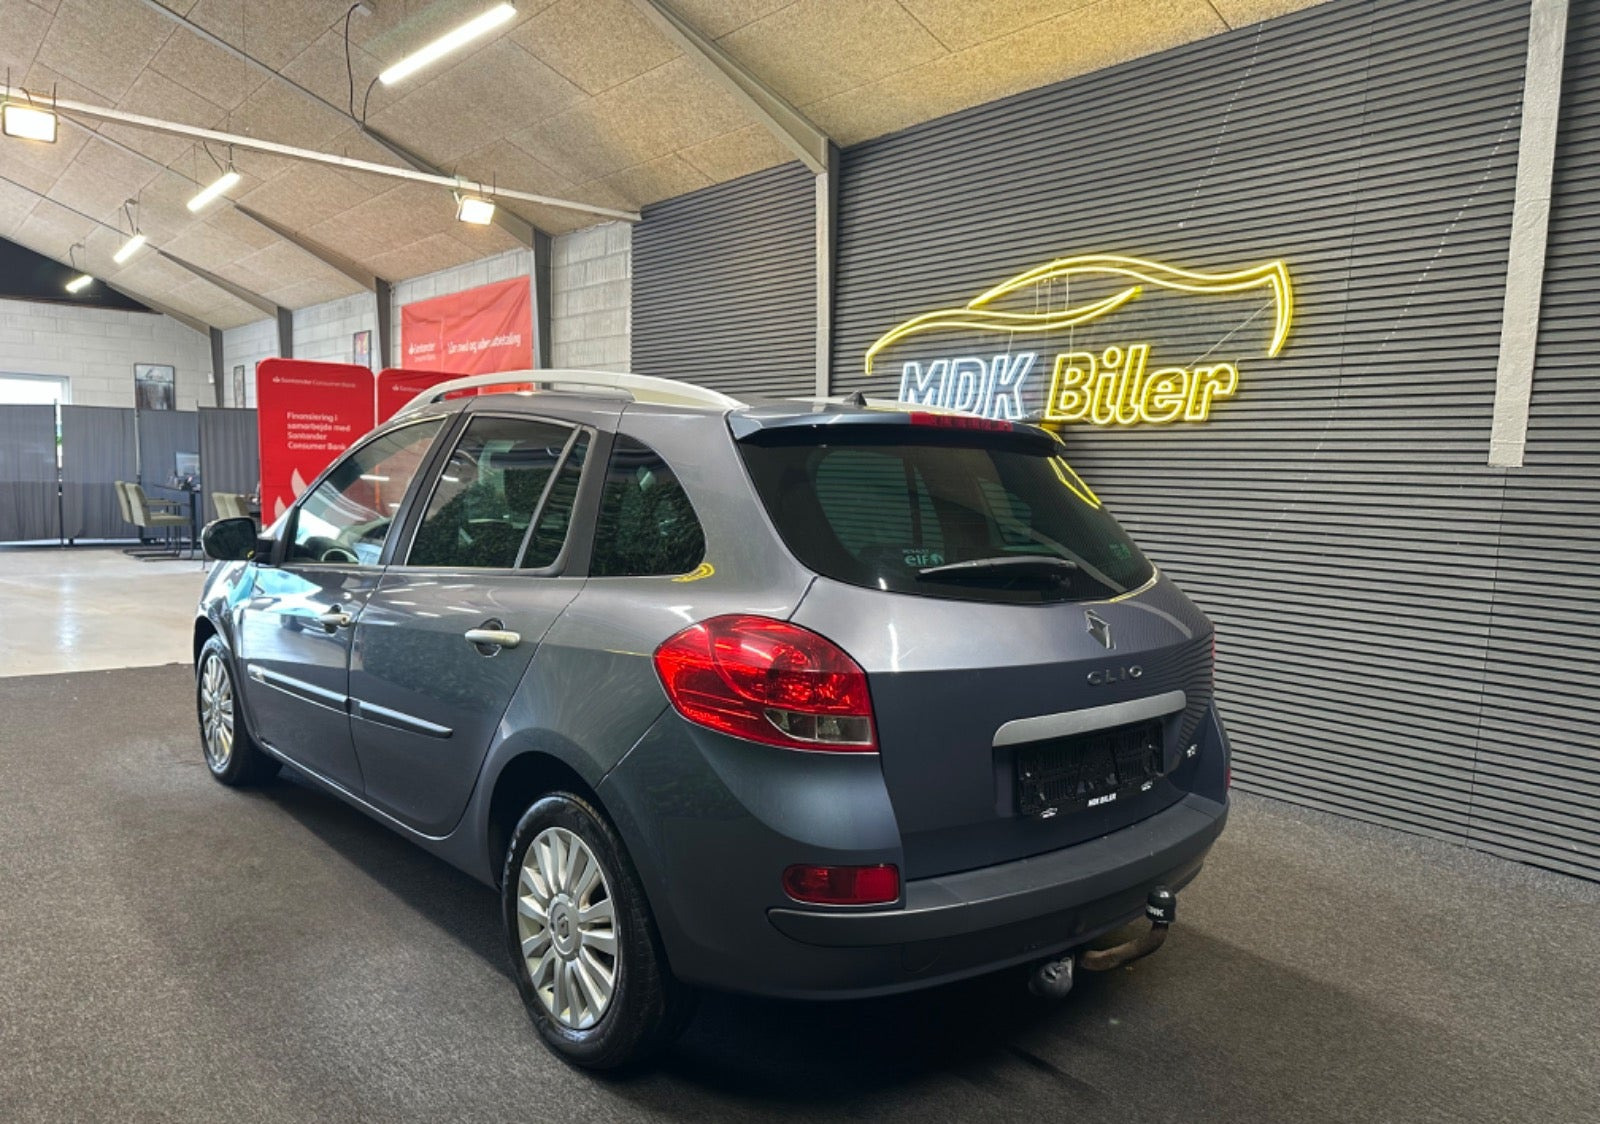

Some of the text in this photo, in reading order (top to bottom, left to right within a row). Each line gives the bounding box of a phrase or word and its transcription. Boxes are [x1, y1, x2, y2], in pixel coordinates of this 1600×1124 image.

[898, 343, 1239, 426] MDK Biler
[287, 411, 334, 423] Finansiering
[287, 423, 352, 432] samarbejde med
[287, 432, 327, 440] Santander
[288, 441, 347, 451] Consumer Bank
[1086, 664, 1143, 685] CLIO
